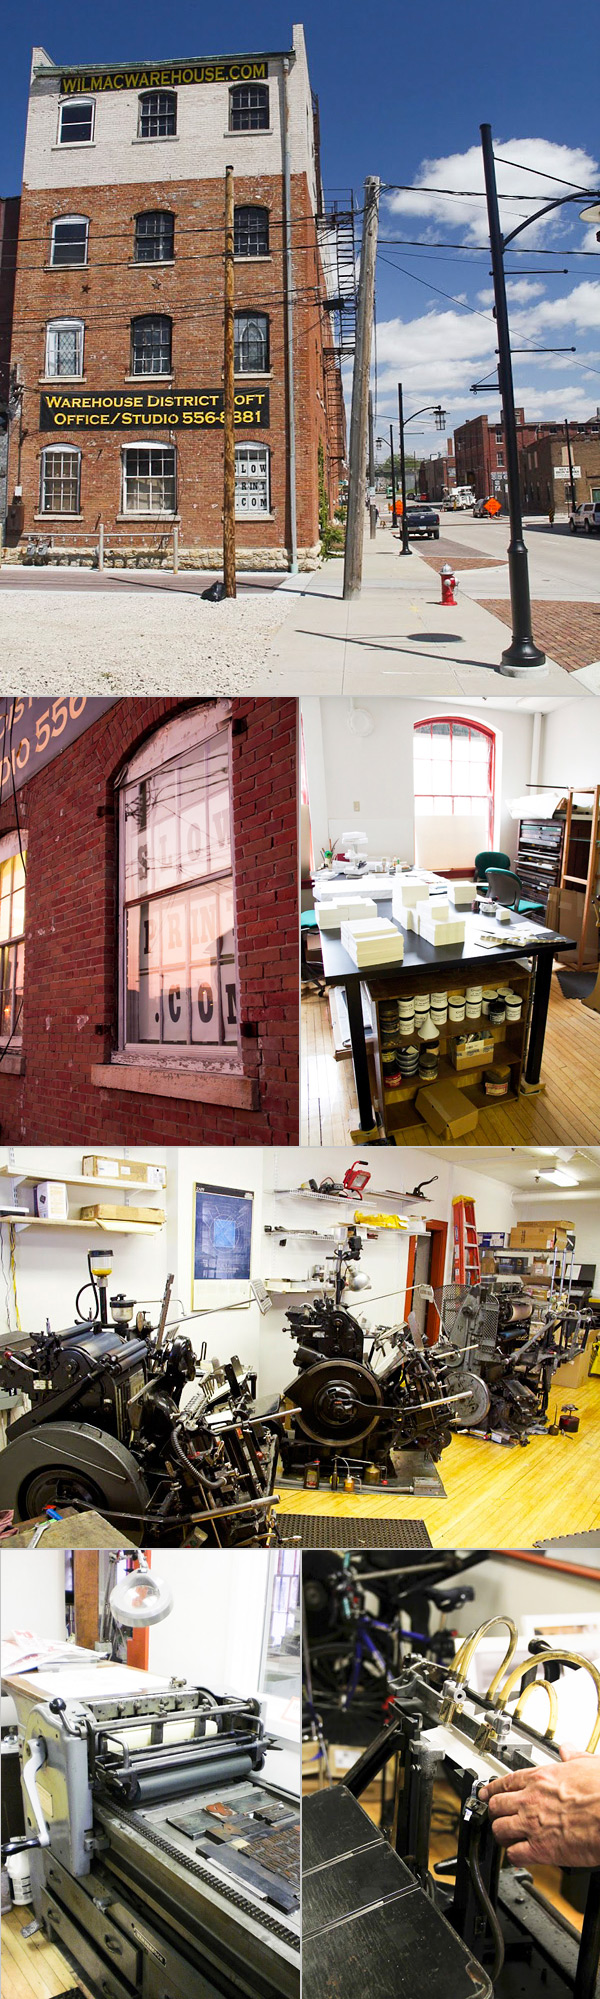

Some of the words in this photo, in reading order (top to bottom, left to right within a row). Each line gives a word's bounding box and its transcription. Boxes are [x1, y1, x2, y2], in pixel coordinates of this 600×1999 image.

[63, 64, 266, 93] WILMACWAREHOUSE.COM
[46, 395, 143, 408] WAREHOUSE
[147, 394, 219, 407] DISTRICT
[222, 394, 265, 406] OFT
